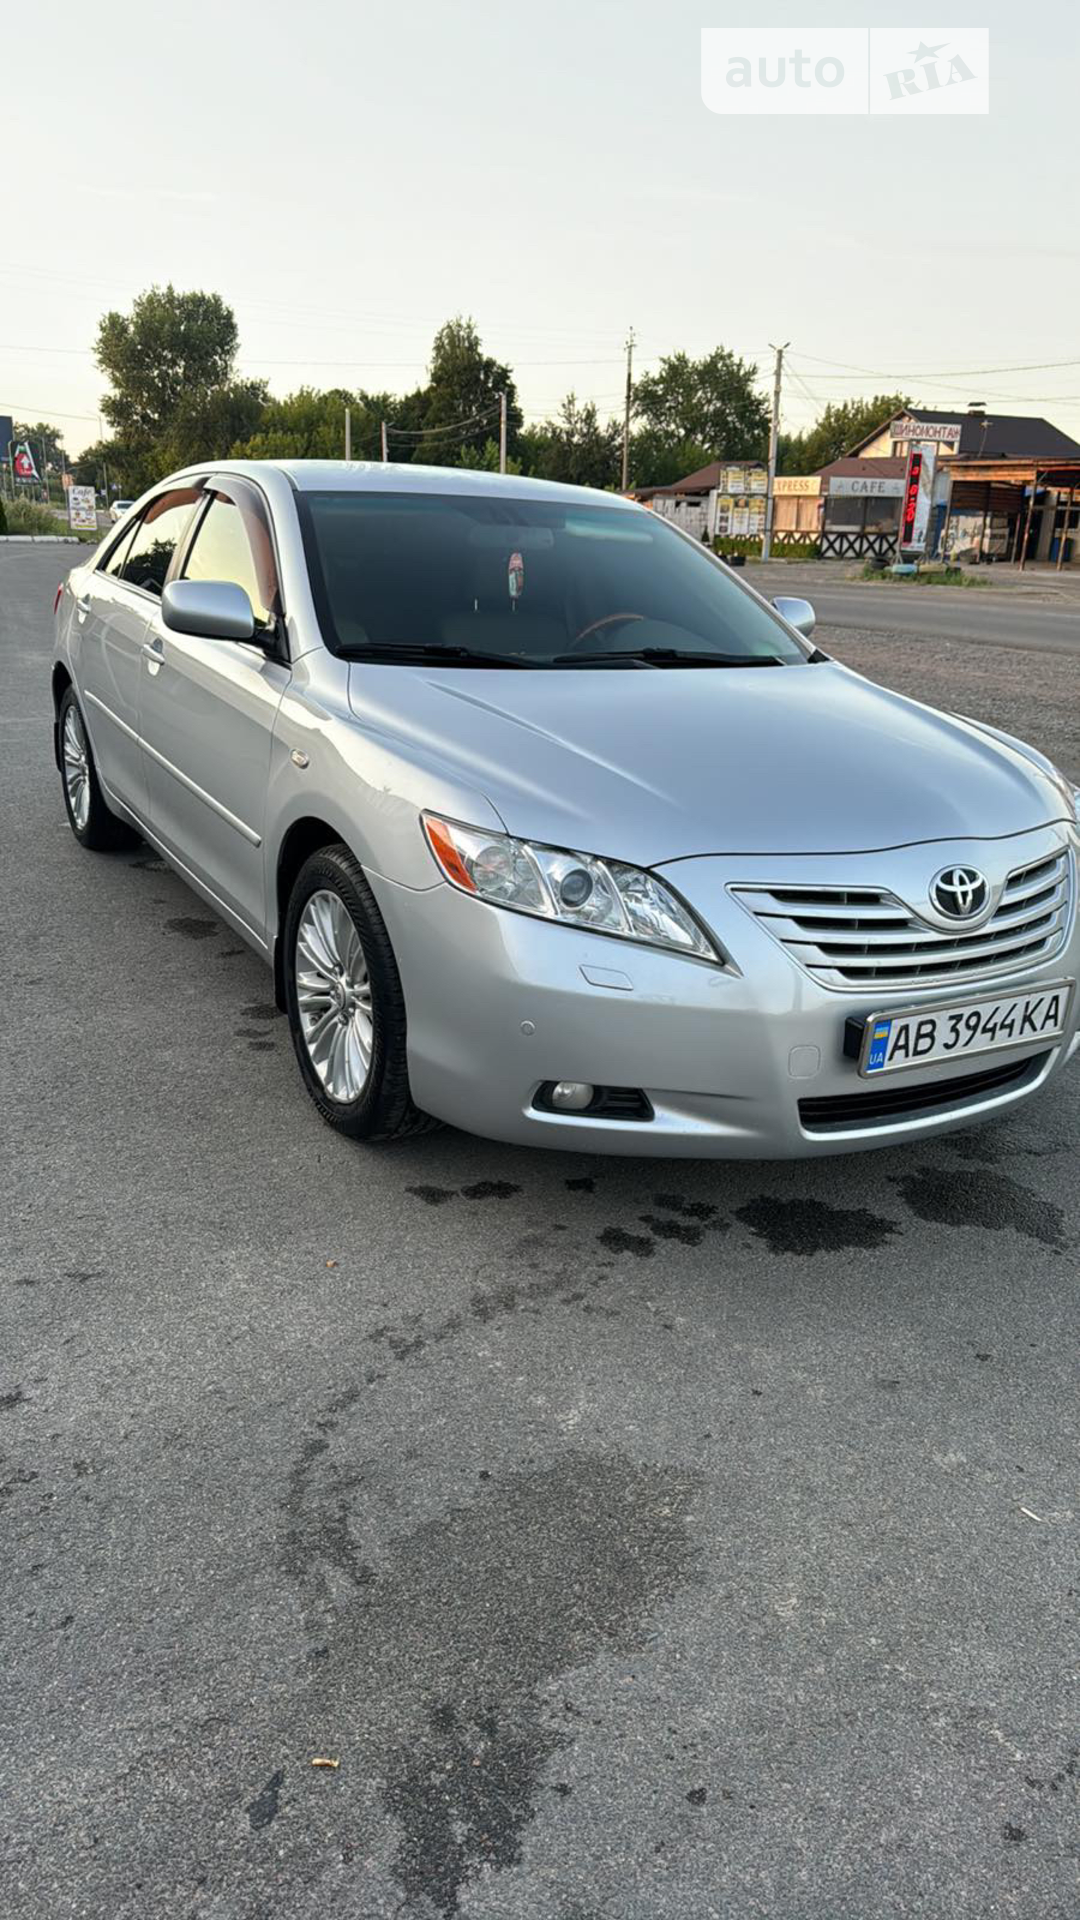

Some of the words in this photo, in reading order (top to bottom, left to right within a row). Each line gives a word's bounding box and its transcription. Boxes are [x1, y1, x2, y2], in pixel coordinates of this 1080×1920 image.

[774, 479, 810, 493] XPRESS
[851, 480, 886, 493] CAFE
[887, 1018, 938, 1062] AB
[869, 1052, 884, 1066] UA
